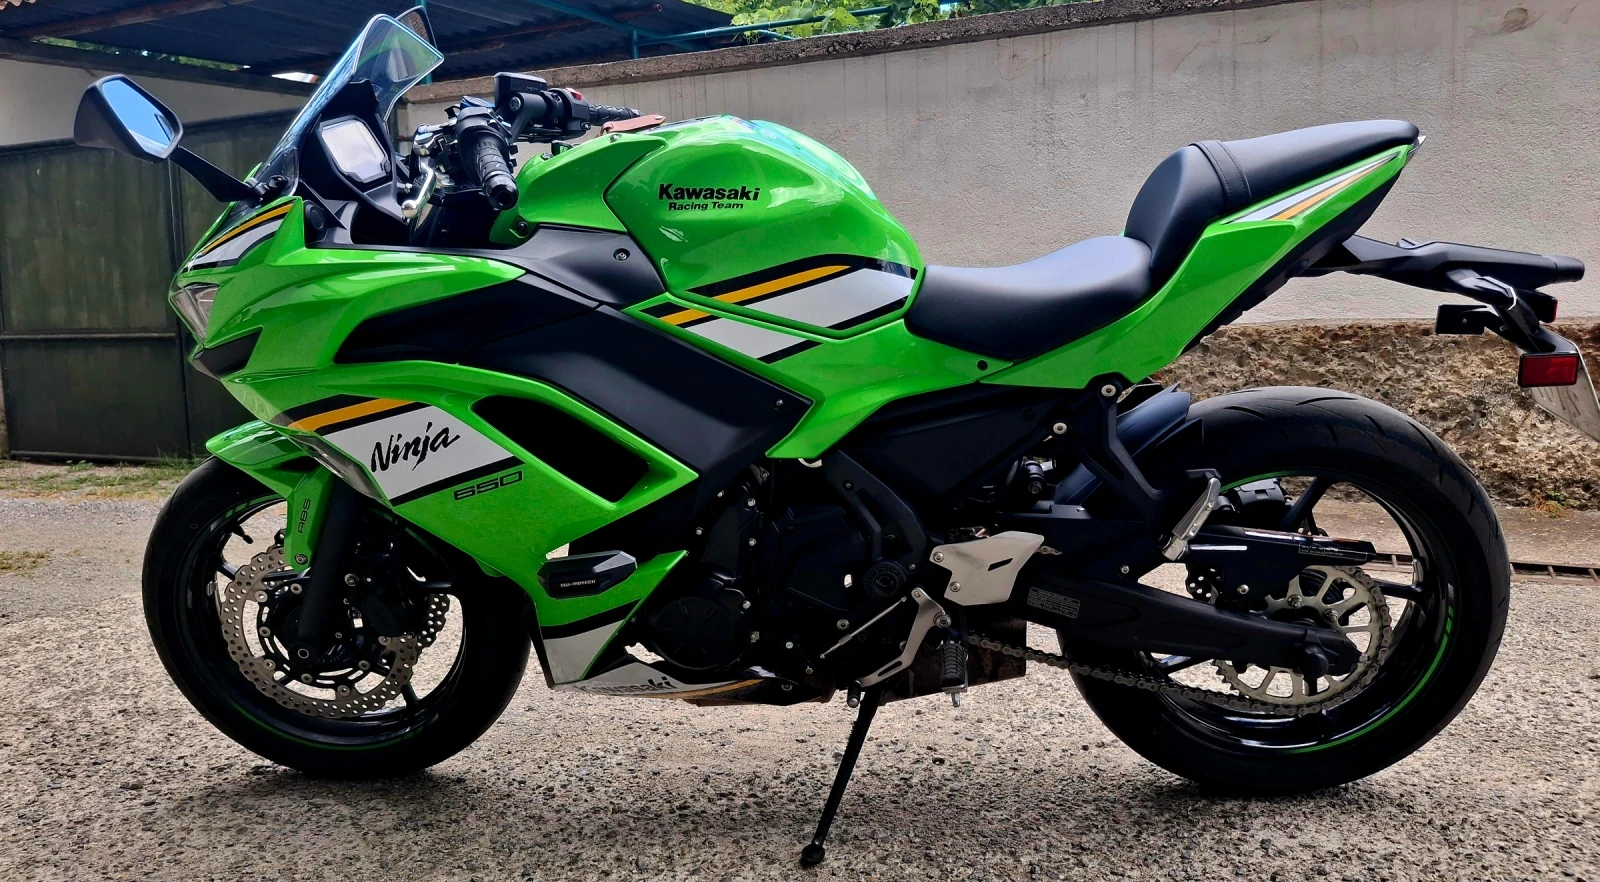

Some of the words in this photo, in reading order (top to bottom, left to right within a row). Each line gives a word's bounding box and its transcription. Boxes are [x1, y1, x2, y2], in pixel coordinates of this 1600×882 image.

[658, 183, 761, 201] Kawasaki
[668, 202, 708, 211] Racing
[711, 201, 744, 209] Team
[370, 421, 461, 473] Ninja
[453, 470, 523, 501] 650
[297, 498, 311, 534] ABS
